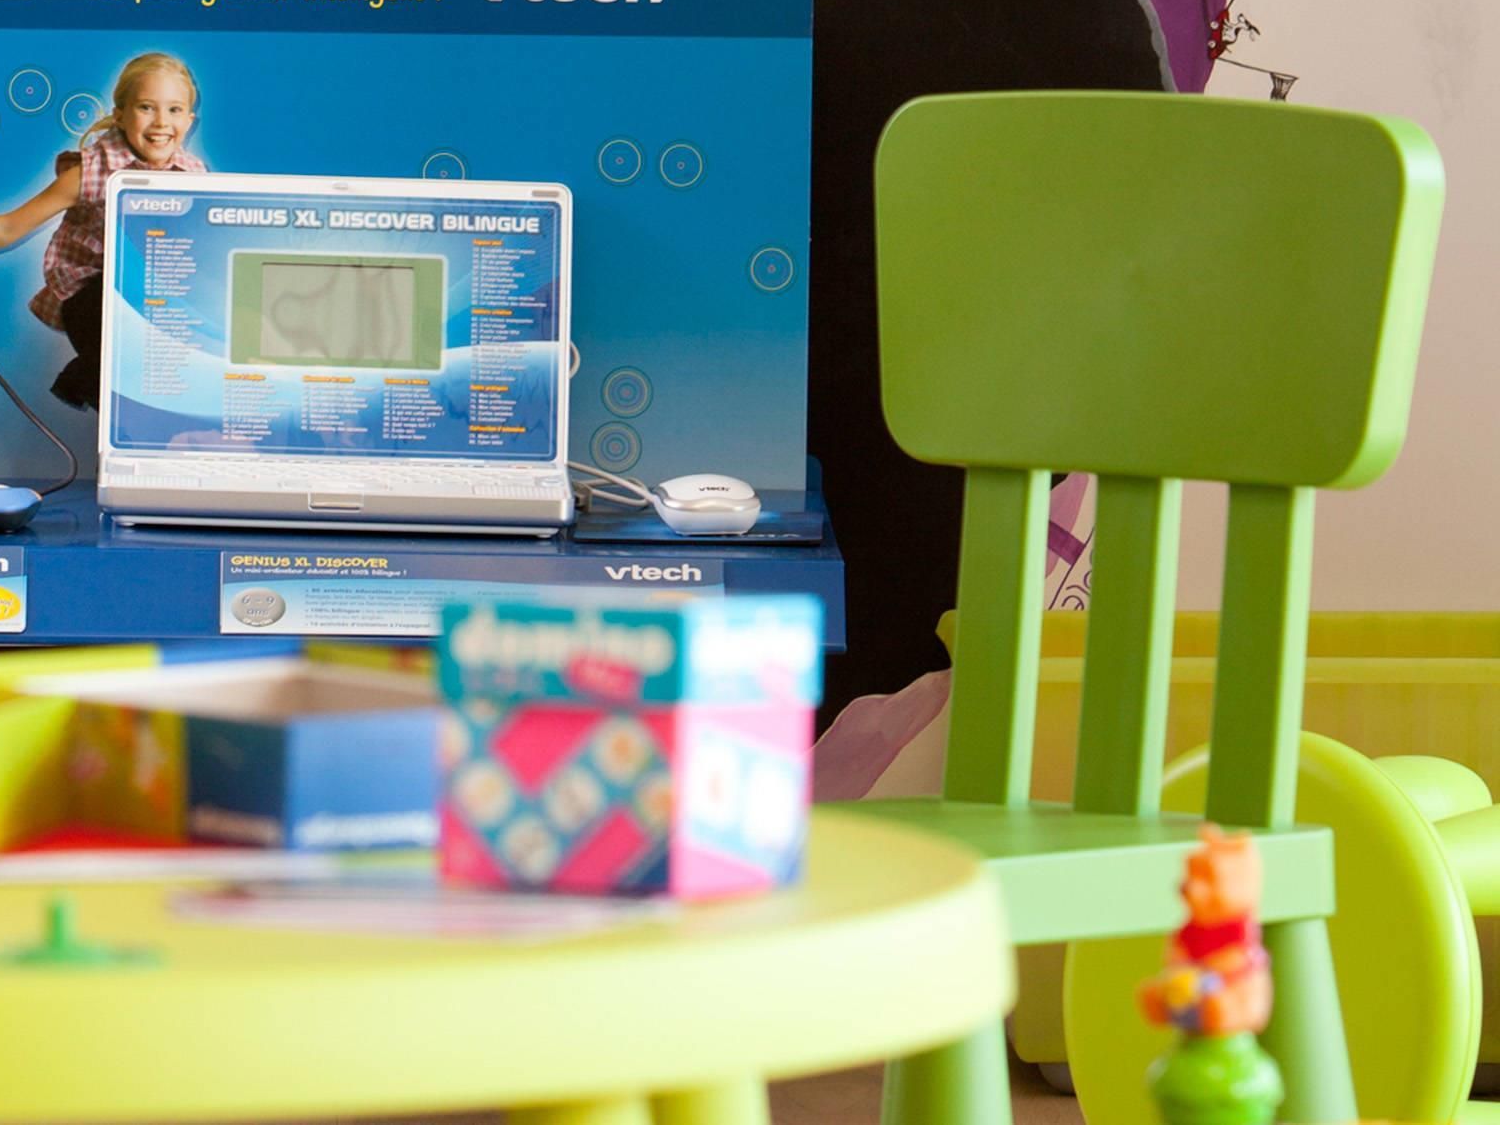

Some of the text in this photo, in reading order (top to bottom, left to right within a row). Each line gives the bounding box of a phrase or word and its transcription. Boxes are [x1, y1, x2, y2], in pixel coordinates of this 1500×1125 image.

[129, 197, 182, 213] vtech
[207, 207, 540, 234] GENIUS XL DISCOVER BILINGUE
[230, 555, 389, 568] GENIUS XL DISCOVER
[604, 563, 702, 582] vtech
